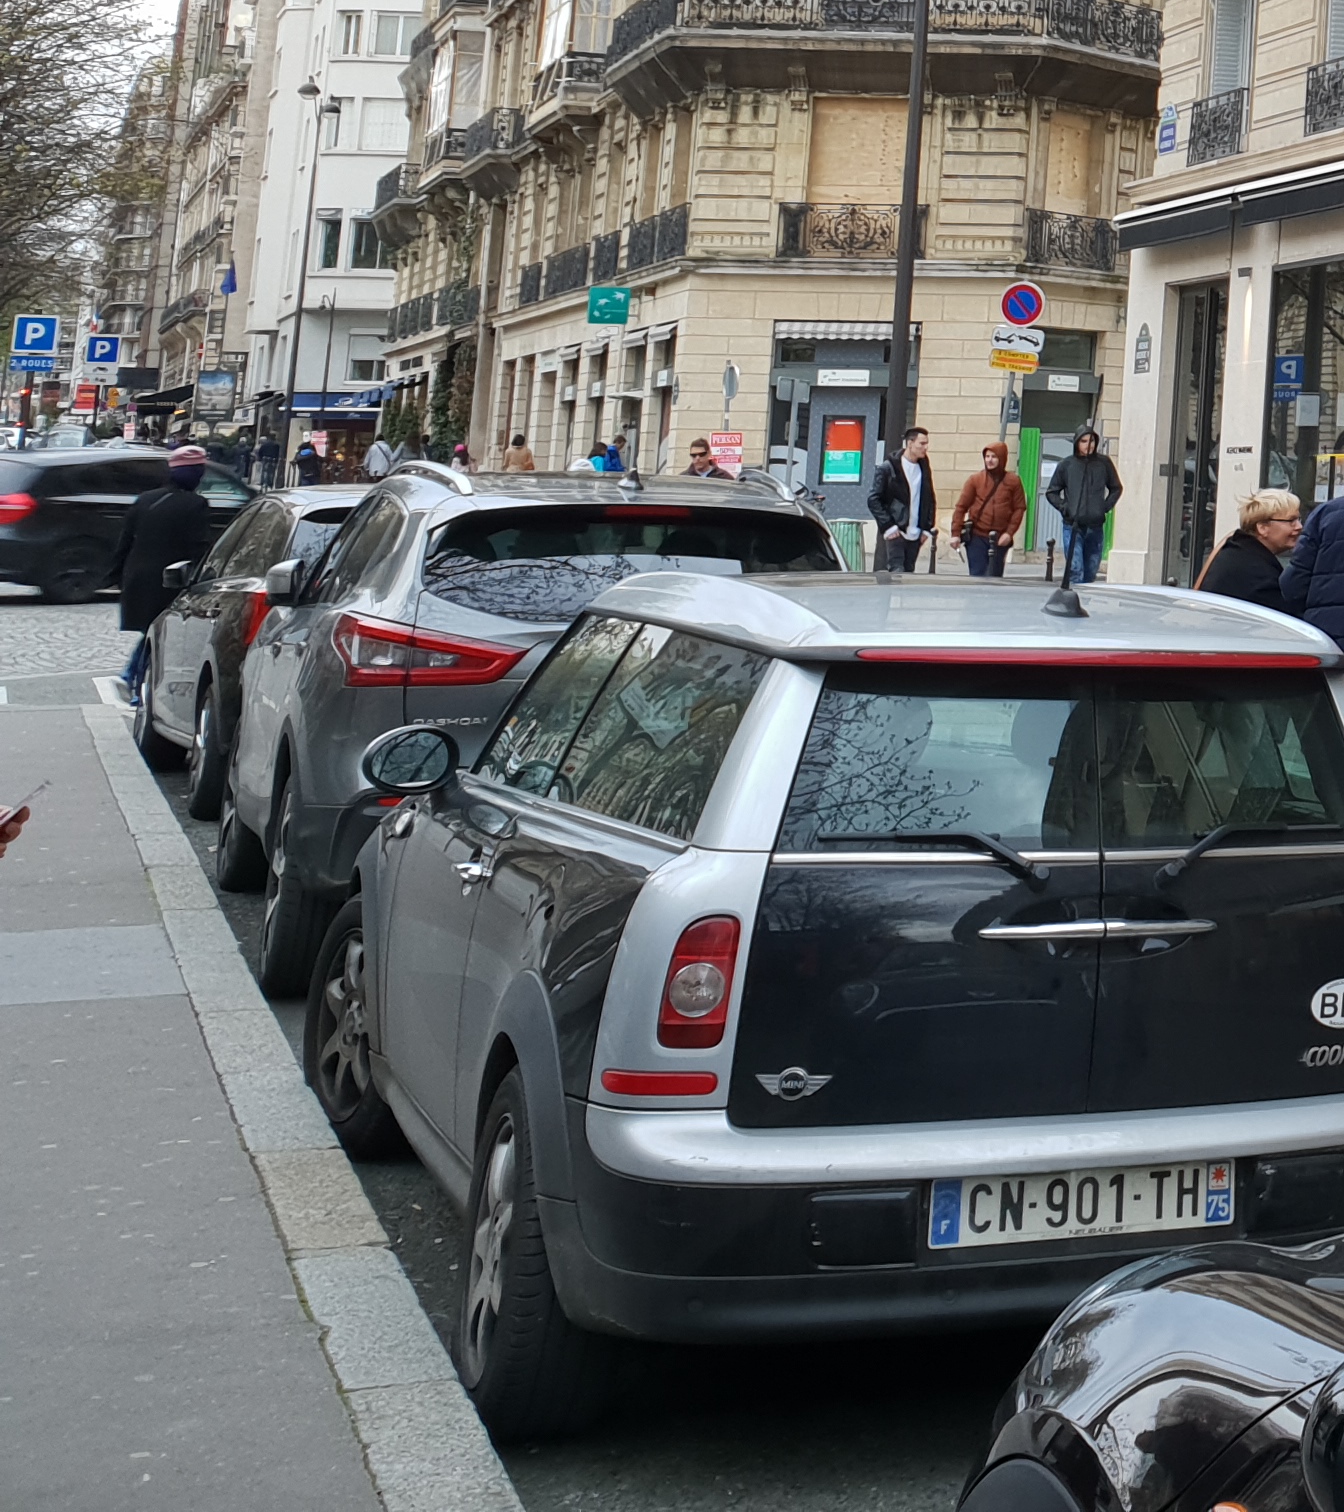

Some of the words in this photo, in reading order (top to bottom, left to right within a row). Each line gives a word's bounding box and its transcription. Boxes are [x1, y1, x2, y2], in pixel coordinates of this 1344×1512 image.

[24, 322, 46, 345] P
[94, 340, 111, 359] P
[781, 1080, 805, 1089] MINI
[940, 1219, 950, 1235] F
[967, 1168, 1200, 1234] CN-901-TH
[1207, 1194, 1230, 1219] 75
